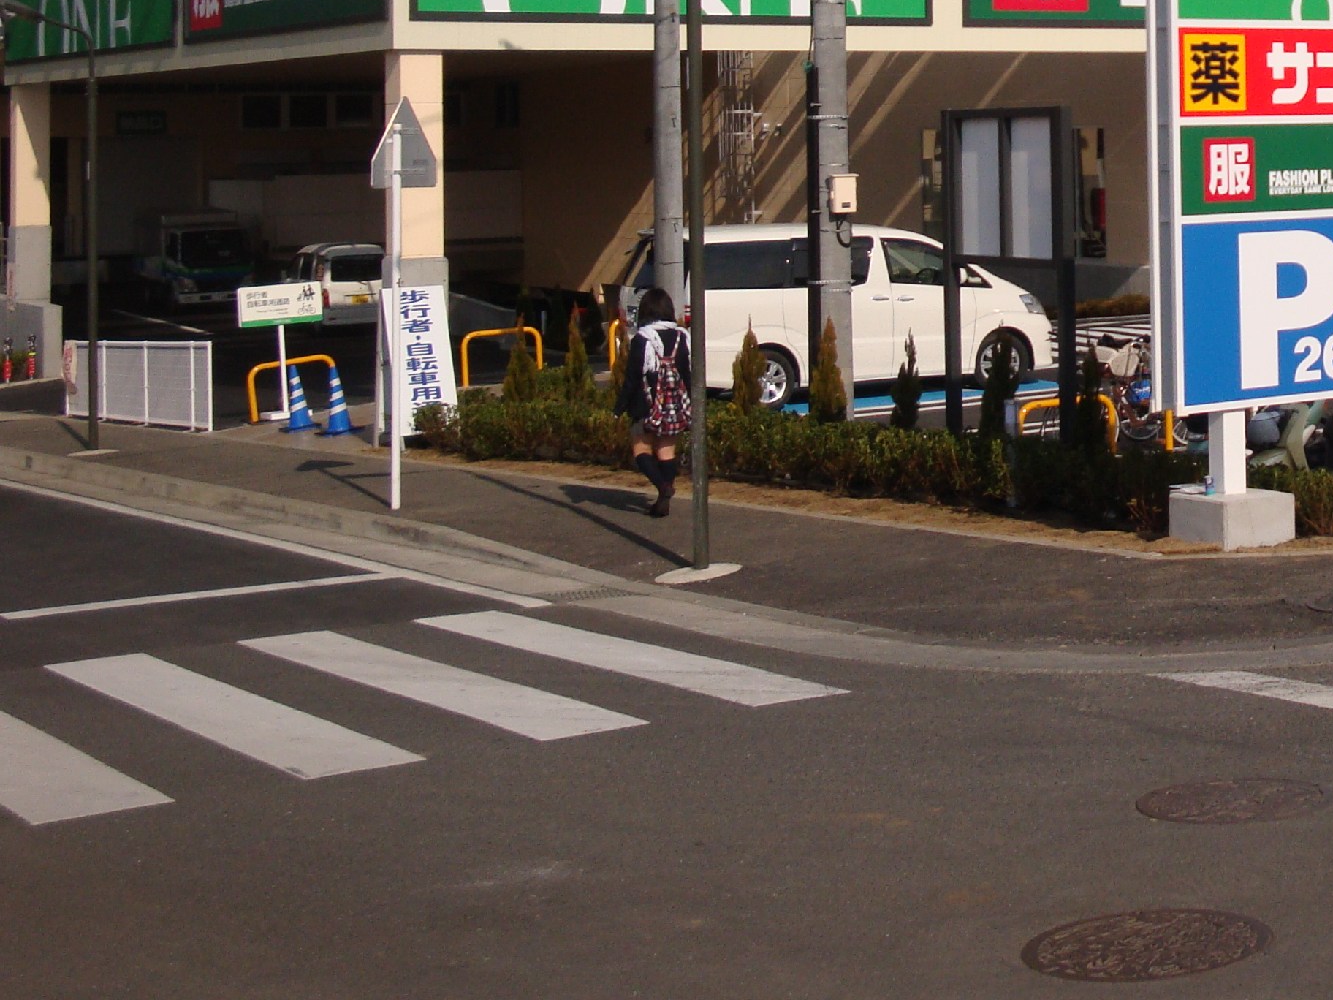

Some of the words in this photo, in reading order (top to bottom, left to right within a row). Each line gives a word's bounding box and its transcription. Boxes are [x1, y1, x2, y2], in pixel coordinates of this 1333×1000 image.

[1190, 42, 1240, 106] 薬
[1208, 143, 1251, 195] 服
[1268, 169, 1319, 188] FASHION
[400, 289, 443, 407] 歩行者・自転車用
